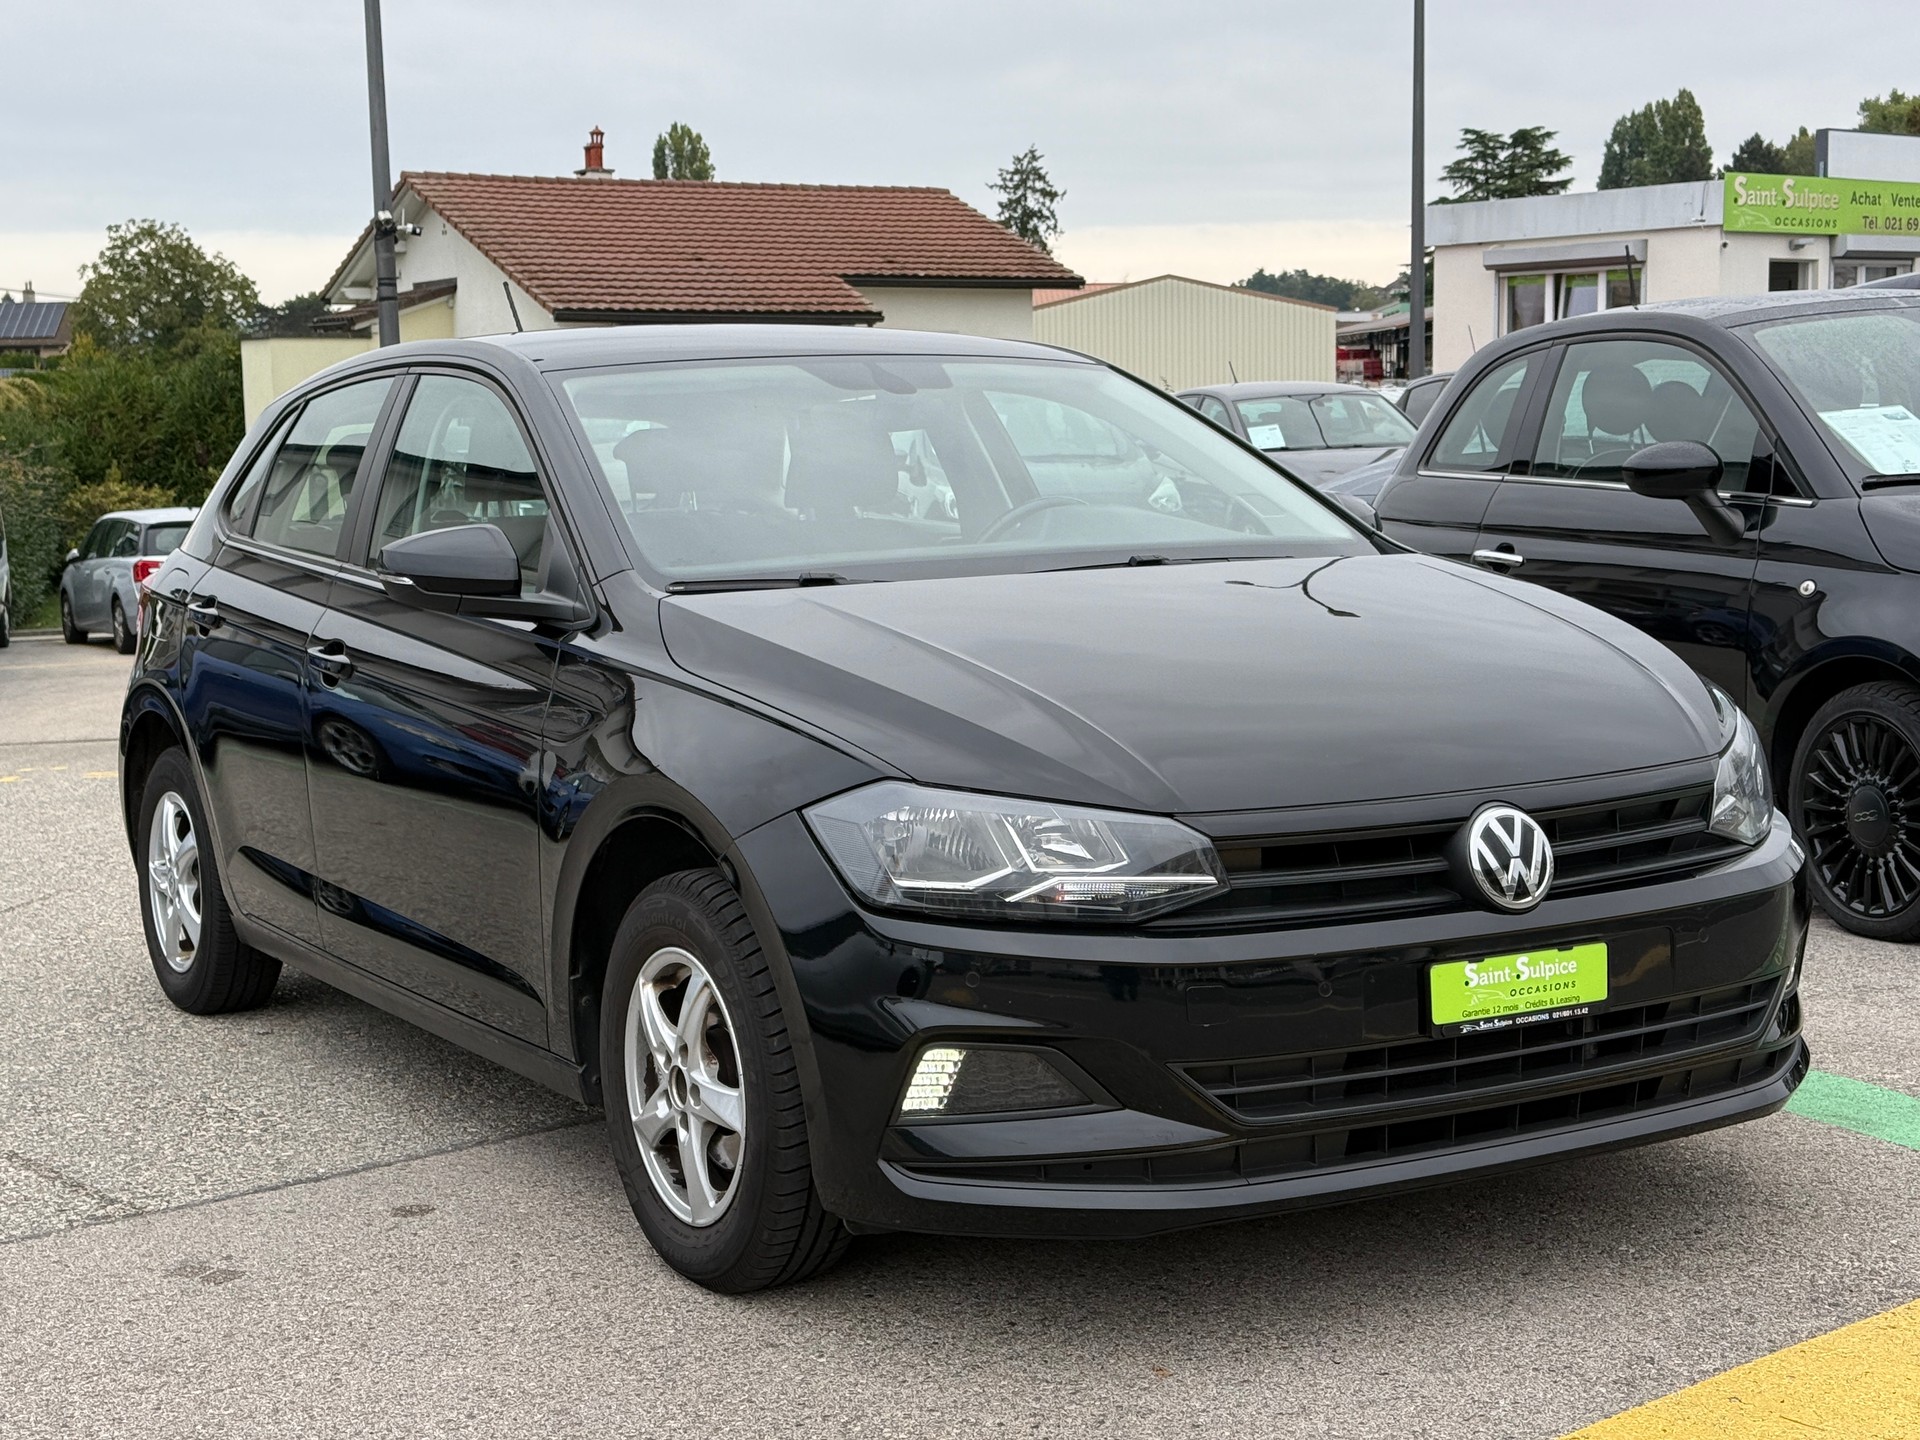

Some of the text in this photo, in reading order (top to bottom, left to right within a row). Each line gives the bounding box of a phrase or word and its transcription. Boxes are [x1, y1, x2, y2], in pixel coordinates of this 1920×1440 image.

[1734, 175, 1840, 212] Saint-Sulpice
[1850, 190, 1920, 209] Achat Vente
[1775, 216, 1838, 229] OCCASIONS
[1884, 216, 1903, 231] 021
[1906, 217, 1920, 232] 69
[1473, 810, 1552, 906] VW
[1464, 955, 1578, 988] Saint-Sulpice
[1509, 980, 1577, 997] OCCASIONS
[1461, 993, 1581, 1018] Garantie 12 mois Crédits & Leasing
[1515, 1013, 1550, 1024] OCCASIONS
